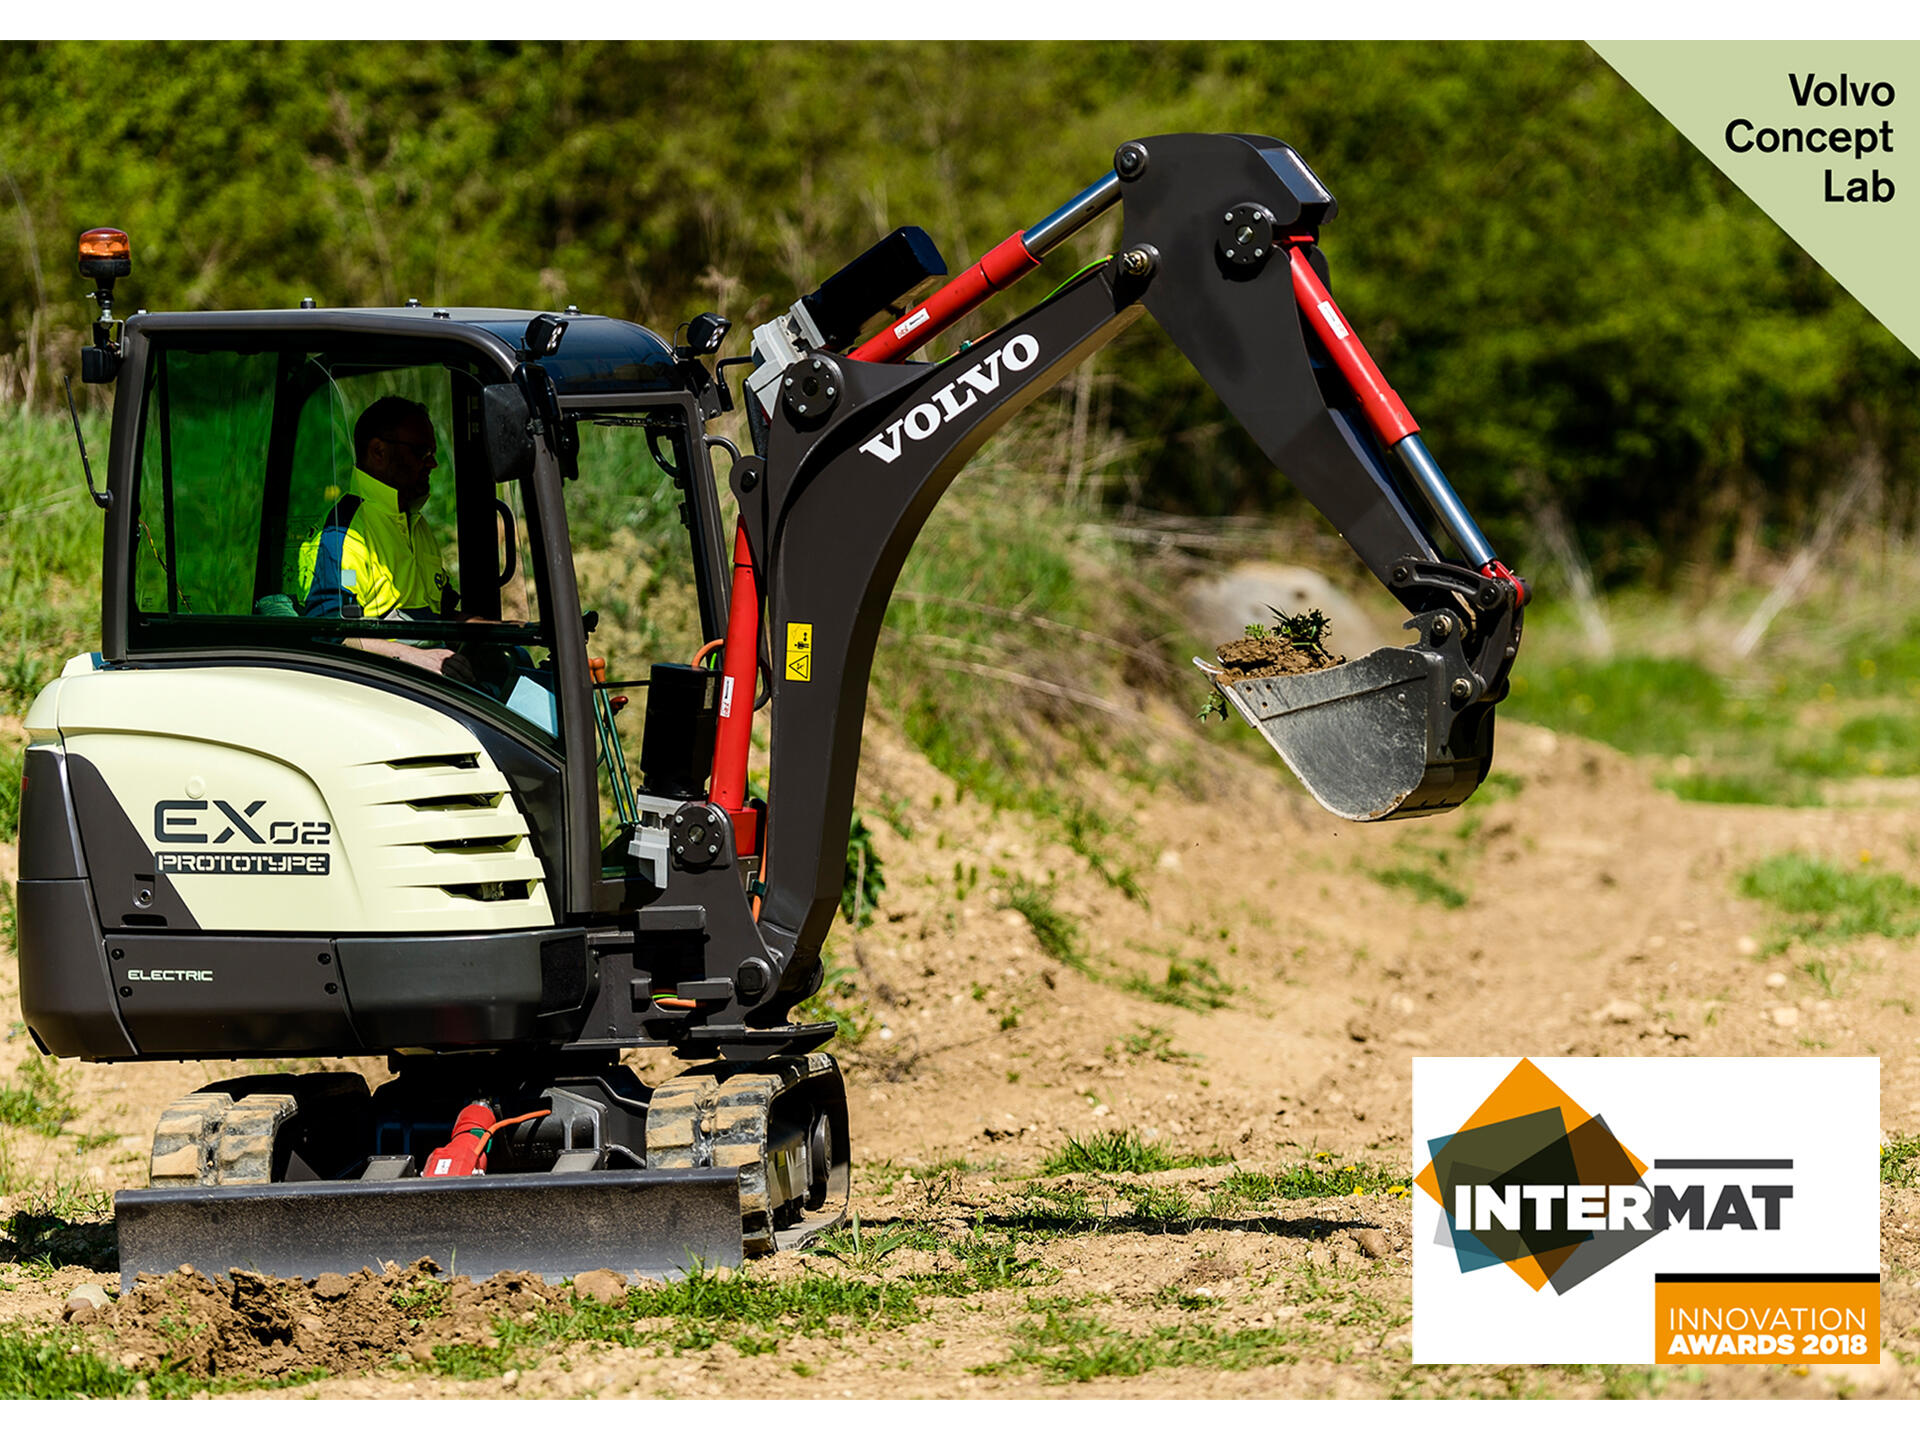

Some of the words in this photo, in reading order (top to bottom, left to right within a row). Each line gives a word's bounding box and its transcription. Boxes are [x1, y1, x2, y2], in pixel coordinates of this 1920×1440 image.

[858, 333, 1040, 464] VOLVO
[157, 853, 327, 873] PROTOTYPE
[127, 969, 214, 982] ELECTRIC
